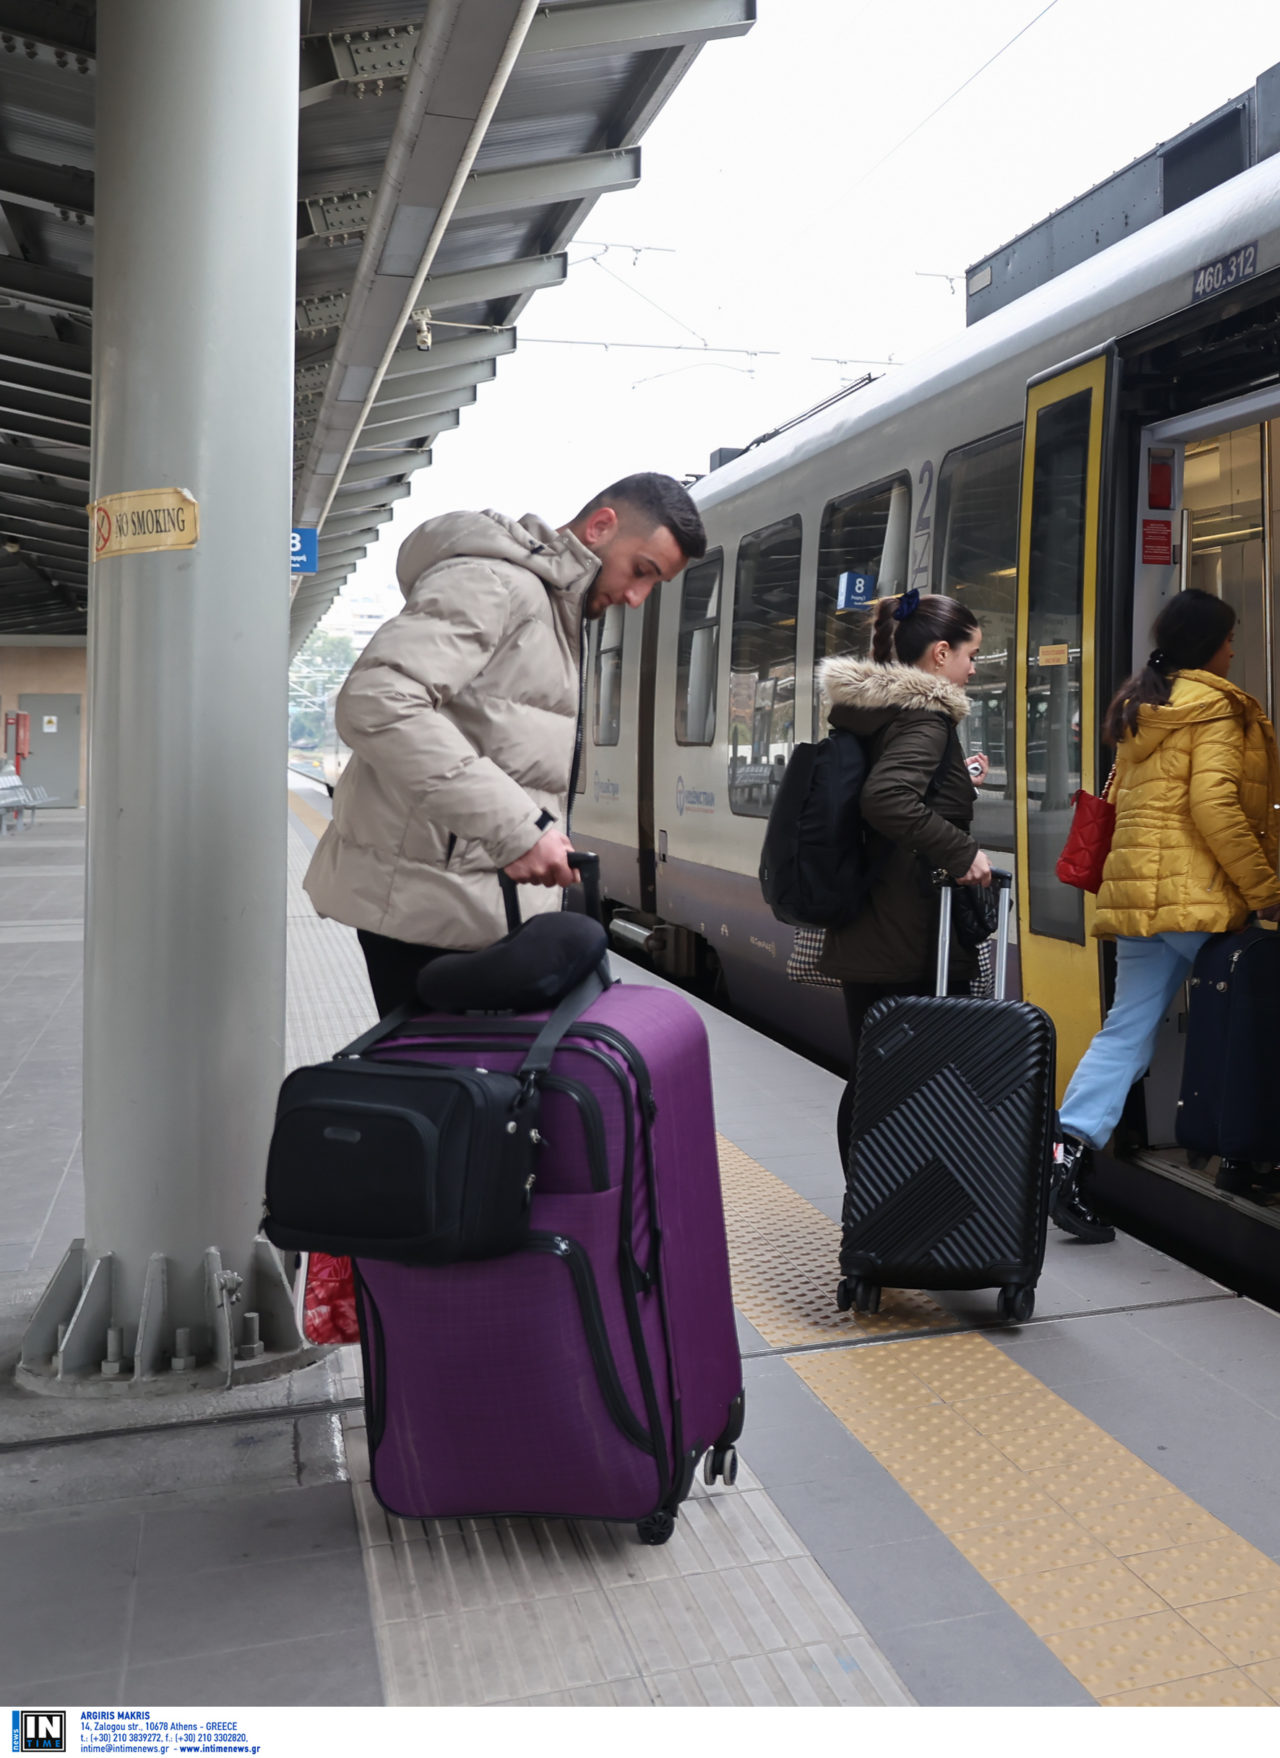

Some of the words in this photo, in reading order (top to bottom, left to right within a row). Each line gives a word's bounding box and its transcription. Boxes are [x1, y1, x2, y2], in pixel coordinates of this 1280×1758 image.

[1195, 246, 1255, 296] 460.312
[915, 459, 934, 533] 2
[115, 512, 129, 538] NO
[130, 507, 185, 536] SMOKING
